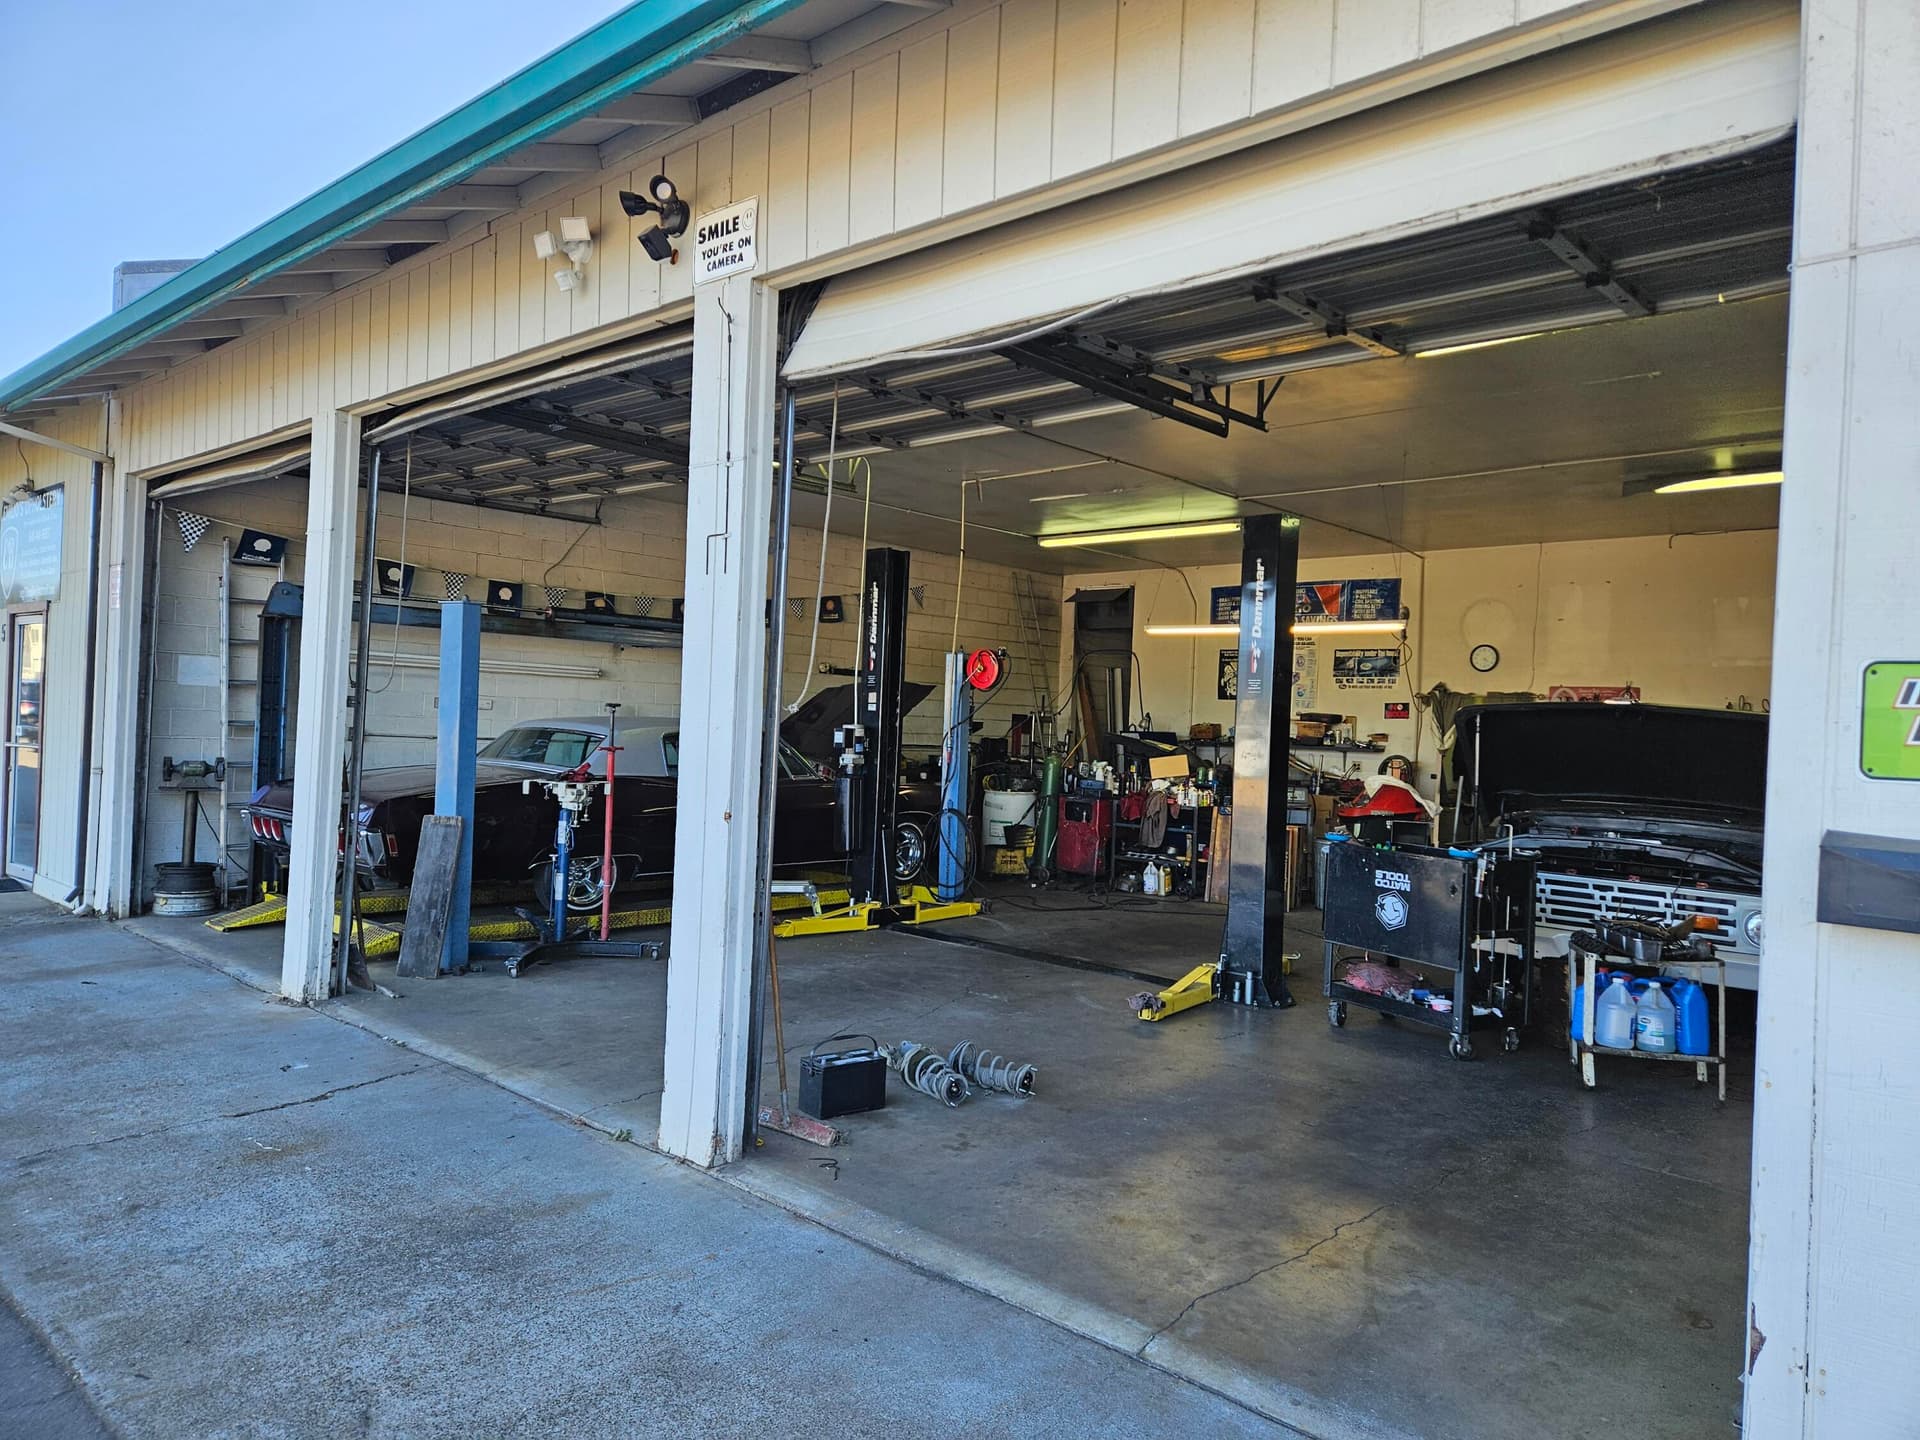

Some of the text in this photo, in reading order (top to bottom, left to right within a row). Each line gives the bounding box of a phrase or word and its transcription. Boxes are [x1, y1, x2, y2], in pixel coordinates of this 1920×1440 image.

[698, 215, 740, 245] SMILE
[701, 235, 752, 261] YOU'RE ON
[706, 252, 744, 273] CAMERA
[1252, 561, 1265, 638] Dannmar
[1374, 878, 1411, 892] MATCO
[1375, 869, 1411, 883] TOOLS
